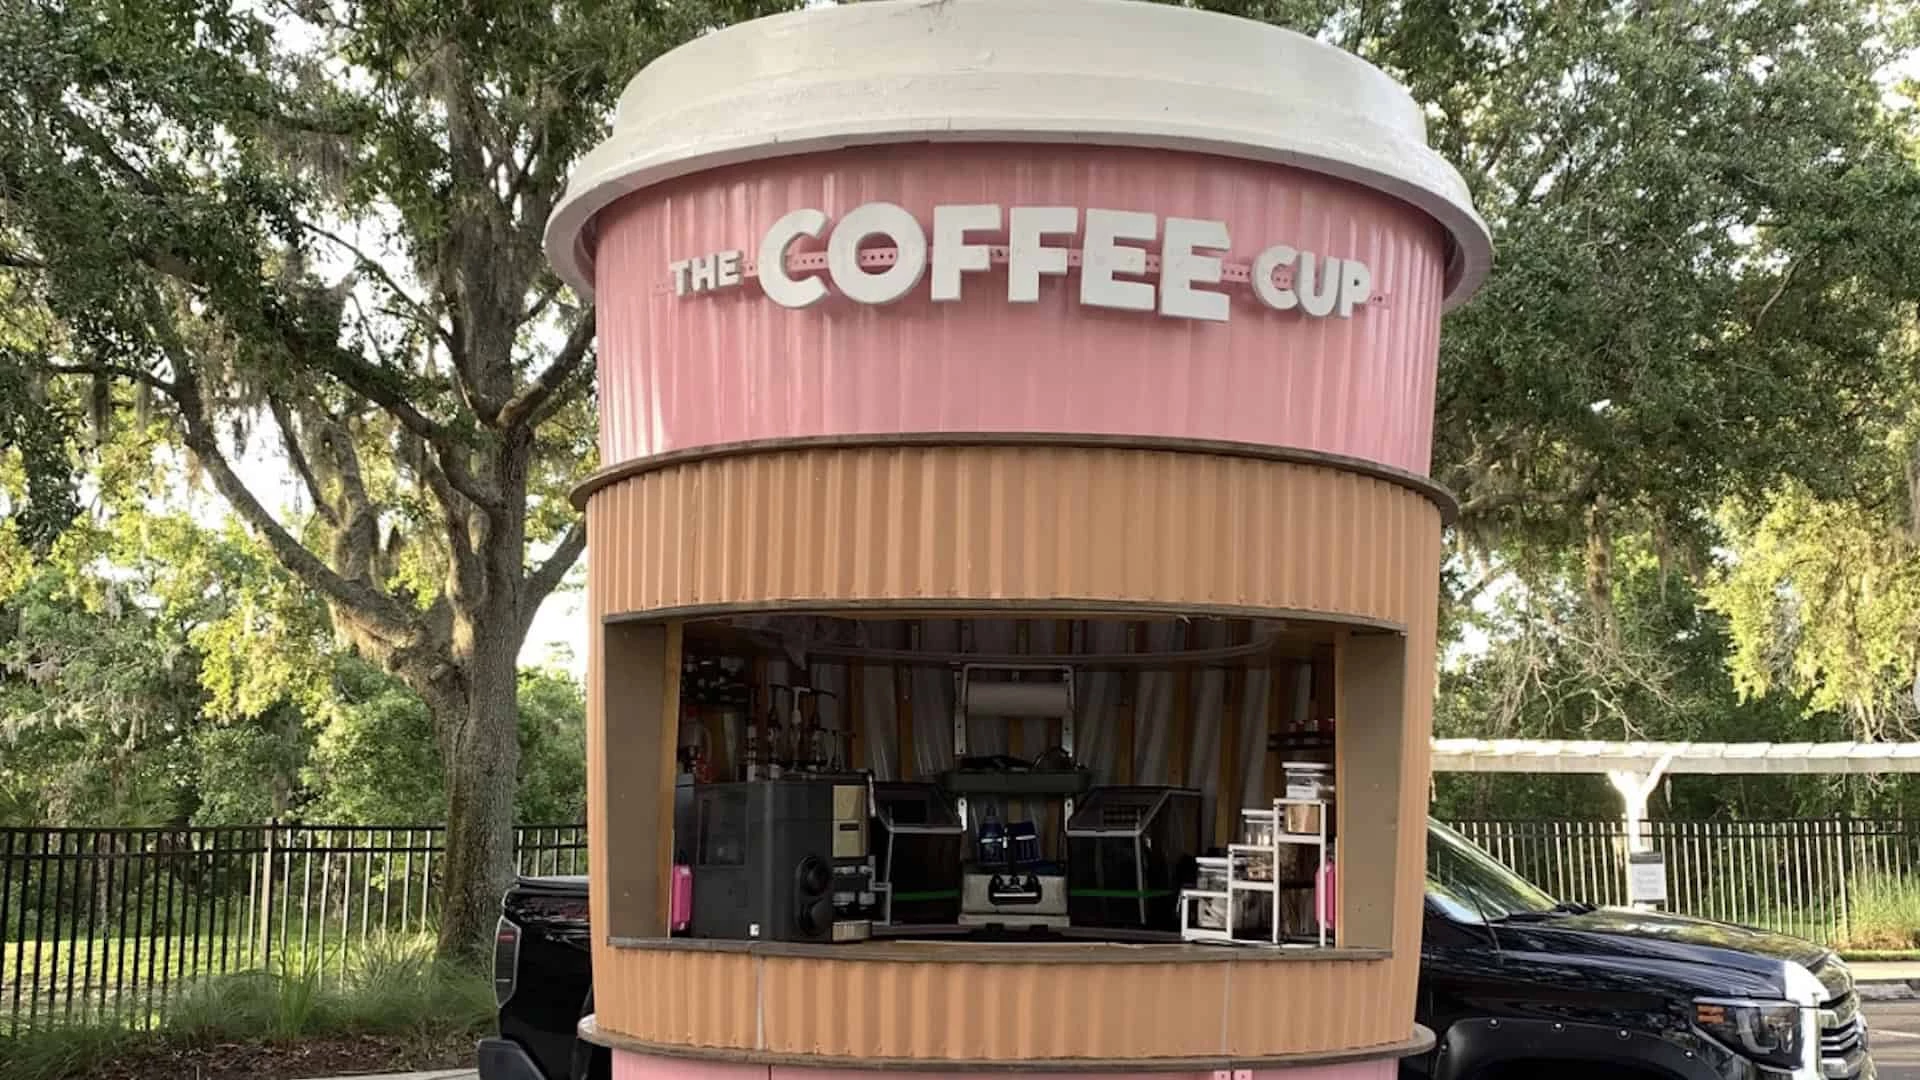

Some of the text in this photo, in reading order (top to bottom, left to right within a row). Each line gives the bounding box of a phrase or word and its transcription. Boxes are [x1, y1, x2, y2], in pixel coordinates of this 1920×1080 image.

[669, 203, 1372, 321] THE COFFEE CUP
